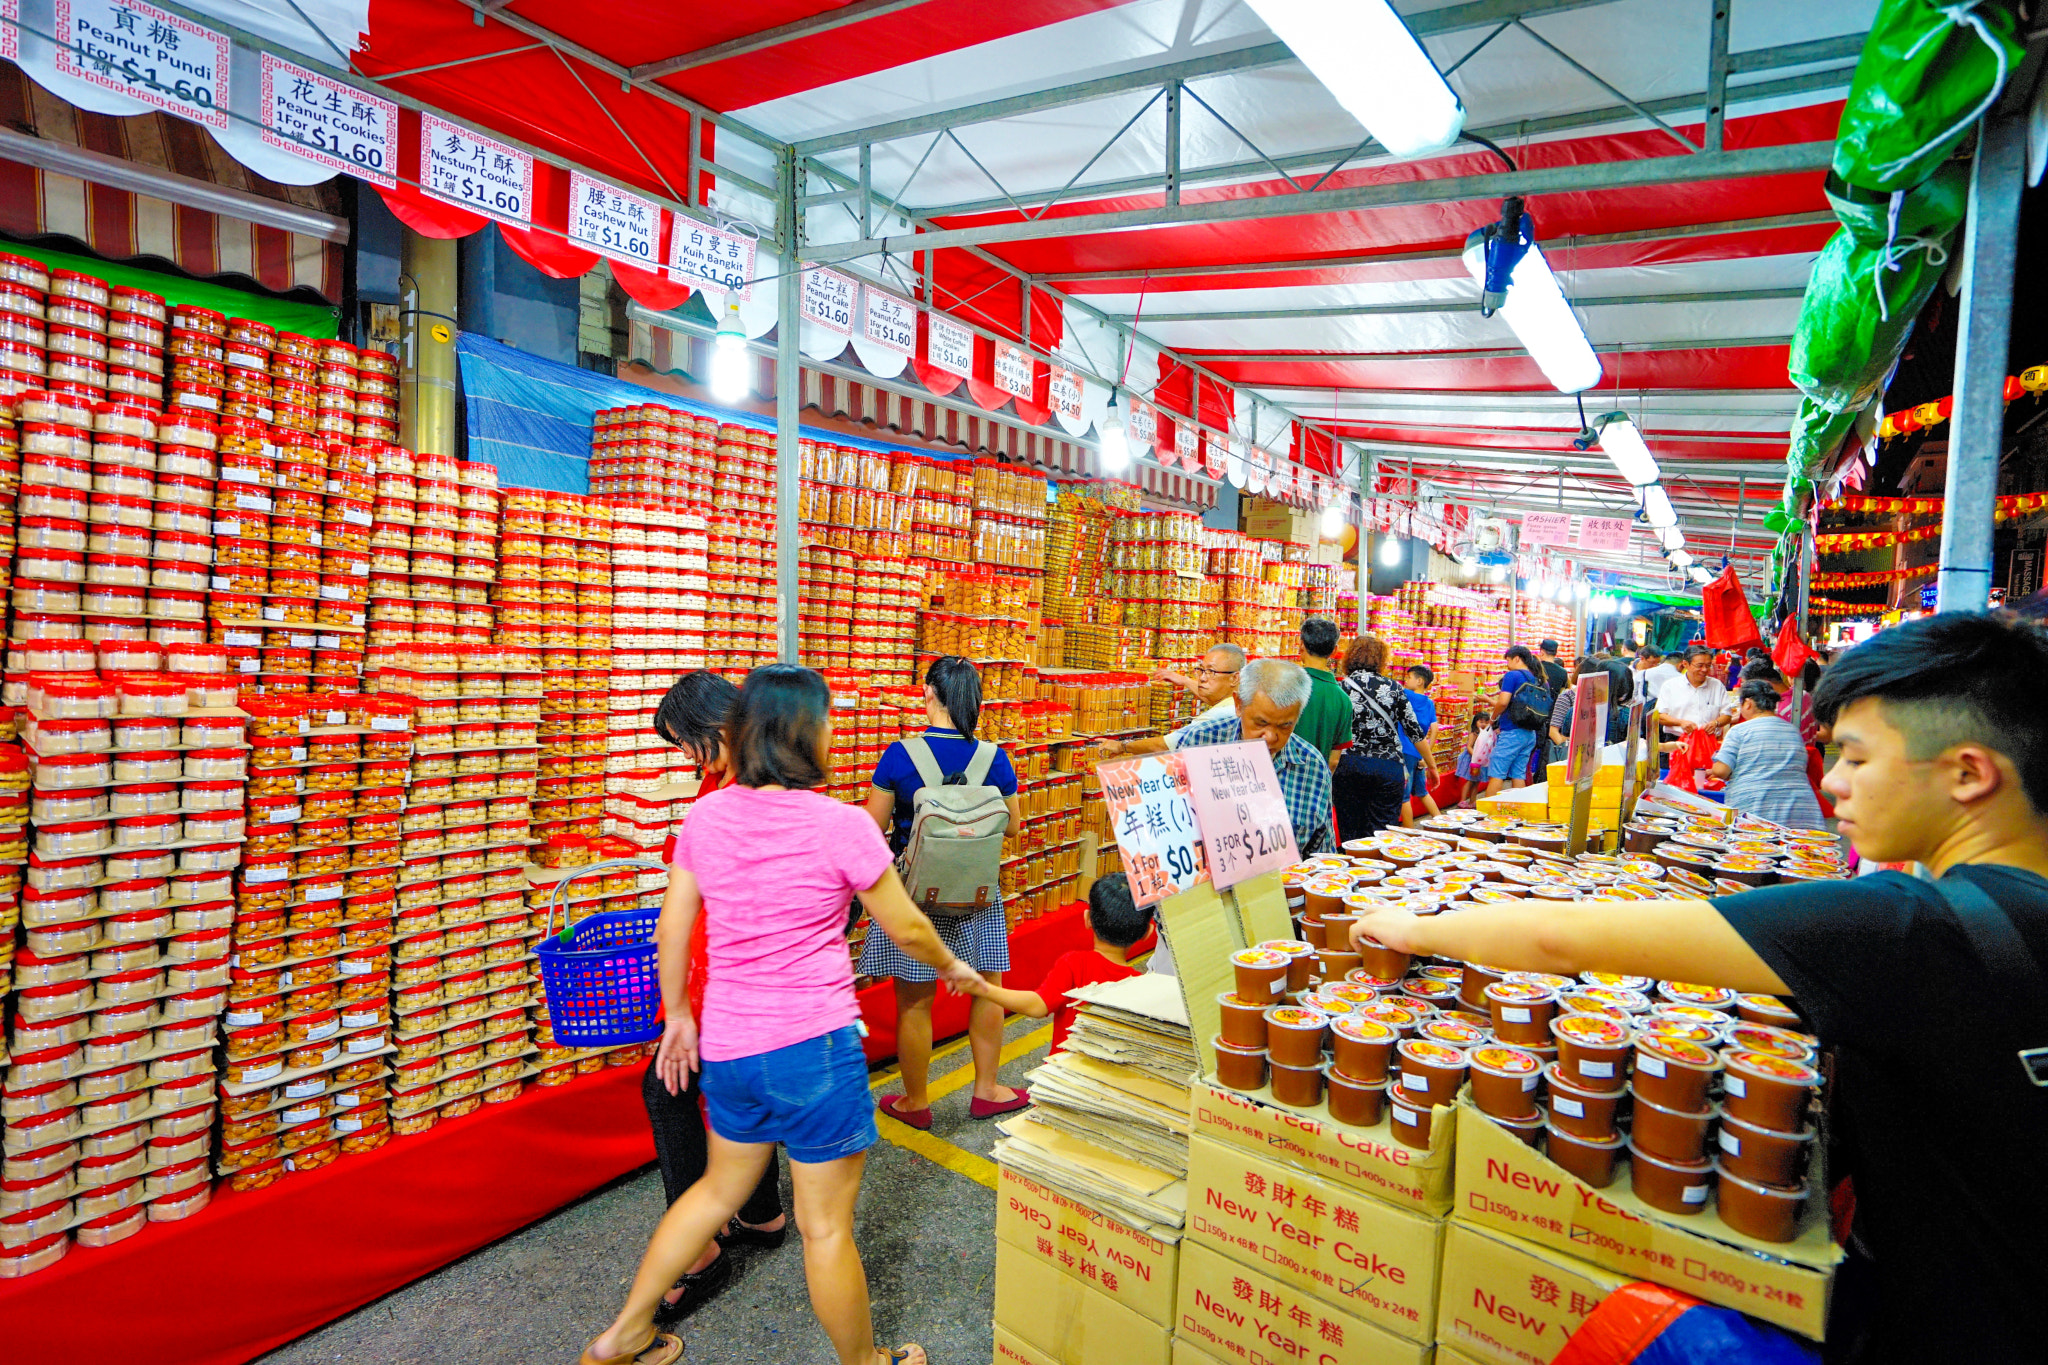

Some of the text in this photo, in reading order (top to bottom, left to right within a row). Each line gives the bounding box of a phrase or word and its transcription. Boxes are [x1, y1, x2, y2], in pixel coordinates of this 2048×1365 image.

[109, 6, 181, 51] 貢糖
[78, 19, 211, 80] Peanut Pundi
[122, 58, 212, 107] $1.60
[291, 78, 378, 126] 花生酥
[277, 96, 385, 145] Peanut Cookies
[312, 126, 382, 167] $1.60
[444, 134, 515, 175] 麥片酥
[431, 148, 523, 191] Nestum Cookies
[461, 177, 520, 213] $1.60
[587, 187, 645, 222] 腰豆酥
[583, 205, 648, 236] Cashew Nut
[602, 226, 649, 257] $1.60
[683, 245, 704, 260] Kuih
[707, 253, 743, 272] Bangkit
[690, 229, 741, 258] 白曼吉
[700, 264, 744, 290] $160
[806, 284, 849, 309] Peanut Cake
[818, 301, 849, 325] $1.60
[869, 308, 911, 332] Peanut Candy
[882, 325, 911, 346] $1.60
[944, 349, 968, 368] $1.60
[1009, 378, 1031, 396] $3.00
[1061, 400, 1080, 416] $4.50
[1527, 515, 1567, 524] CASHIER
[1106, 772, 1187, 801] New Year Cake
[1210, 755, 1256, 785] 年糕(小)
[1211, 780, 1267, 801] New Year Cake
[1236, 802, 1251, 825] (S)
[1223, 833, 1241, 851] FOR
[1142, 854, 1159, 871] For
[1212, 1114, 1233, 1136] 150g
[1283, 1139, 1306, 1157] 200g
[1360, 1168, 1386, 1187] 400g
[1487, 1158, 1561, 1198] New
[1244, 1171, 1360, 1234] 發財年糕
[1009, 1197, 1151, 1282] New Year Cake
[1206, 1187, 1406, 1285] New Year Cake
[1489, 1201, 1518, 1222] 150g
[1592, 1232, 1624, 1256] 200g
[1708, 1269, 1745, 1293] 400g
[1037, 1235, 1119, 1292] 發財年糕
[1207, 1223, 1227, 1242] 150g
[1277, 1254, 1300, 1273] 200g
[1354, 1289, 1380, 1309] 400g
[1195, 1288, 1310, 1359] New Year
[1232, 1276, 1344, 1347] 發財年糕
[1473, 1287, 1547, 1336] New
[1196, 1324, 1216, 1343] 150g
